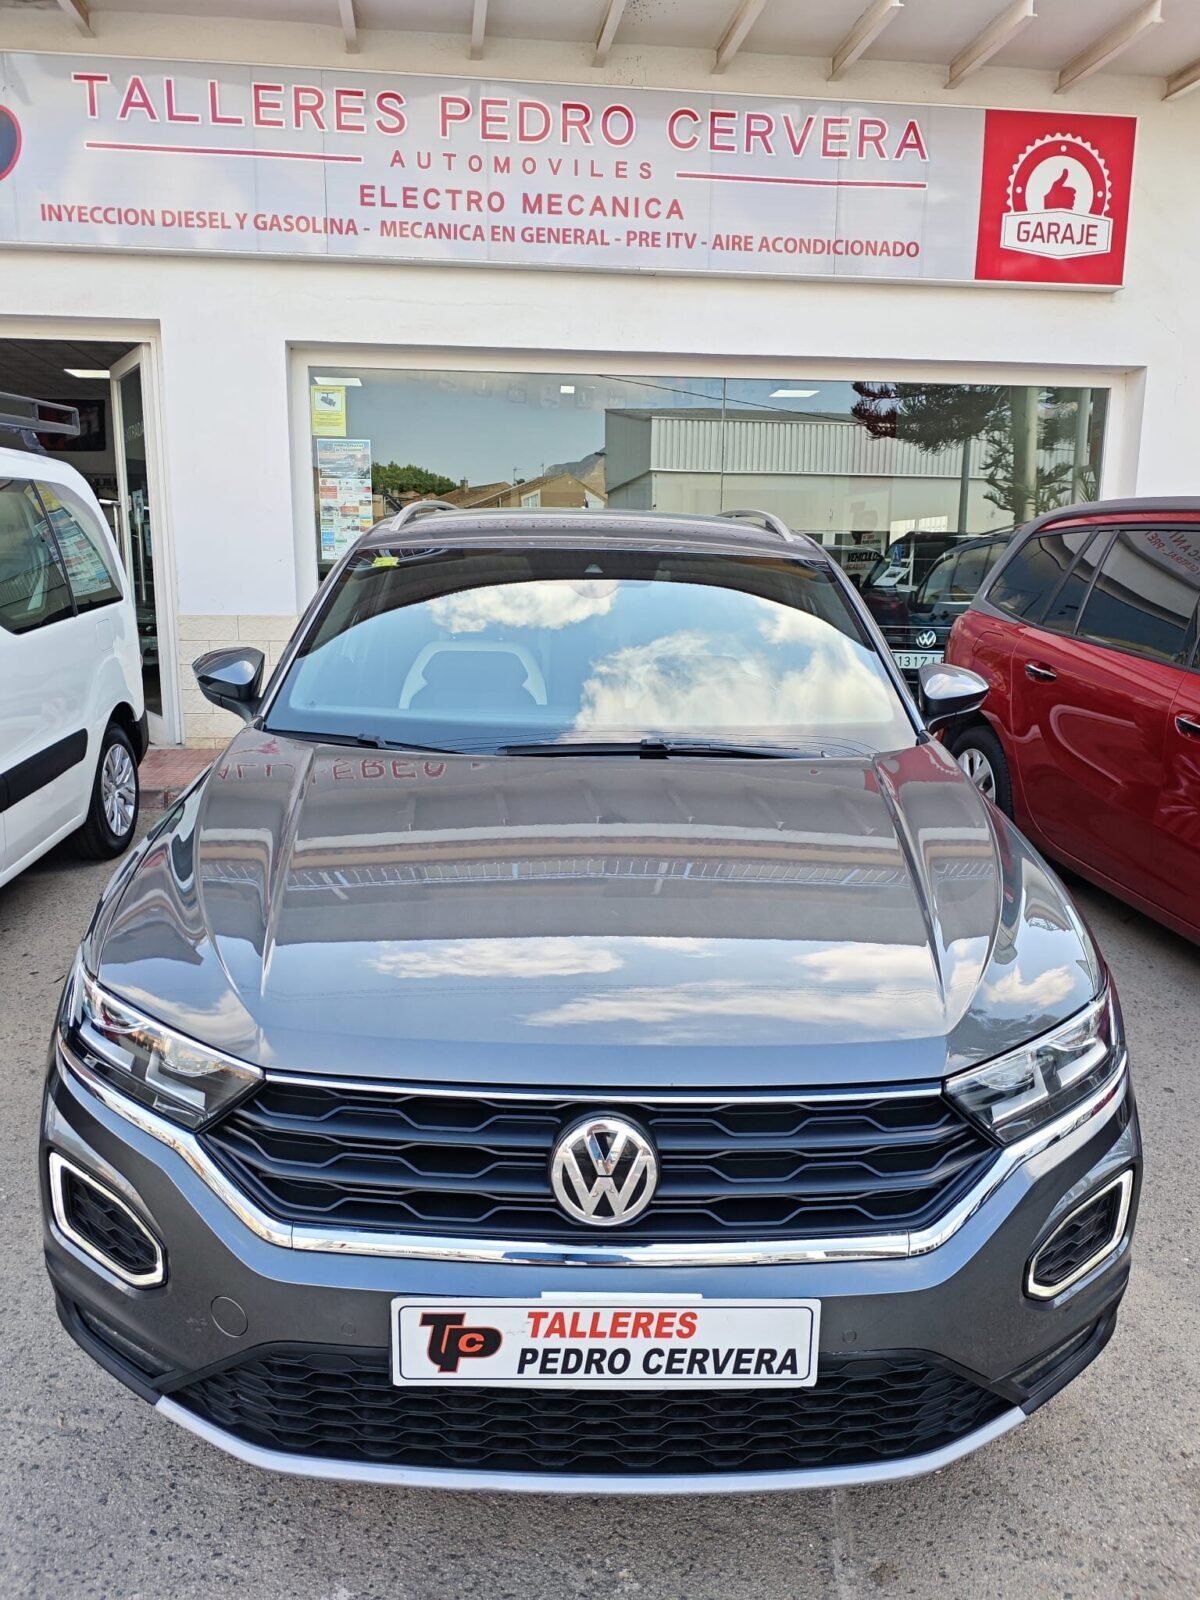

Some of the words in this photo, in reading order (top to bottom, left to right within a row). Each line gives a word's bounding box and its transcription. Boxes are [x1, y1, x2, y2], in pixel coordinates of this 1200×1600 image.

[73, 73, 407, 134] TALLERES
[440, 96, 635, 146] PEDRO
[668, 107, 928, 162] CERVERA
[390, 149, 654, 181] AUTOMOVILES
[358, 184, 505, 214] ELECTRO
[521, 192, 685, 220] MECANICA
[40, 203, 156, 226] INYECCION
[161, 209, 231, 230] DIESEL
[235, 212, 248, 230] Y
[253, 213, 359, 236] GASOLINA
[379, 219, 485, 242] MECANICA
[490, 224, 516, 243] EN
[520, 225, 610, 247] GENERAL
[625, 230, 661, 249] PRE
[665, 231, 698, 250] ITV
[712, 233, 753, 252] AIRE
[757, 236, 922, 258] ACONDICIONADO
[1016, 220, 1098, 246] GARAJE
[898, 655, 928, 667] 1317
[527, 1311, 699, 1340] TALLERES
[516, 1347, 631, 1376] PEDRO
[642, 1347, 799, 1375] CERVERA
